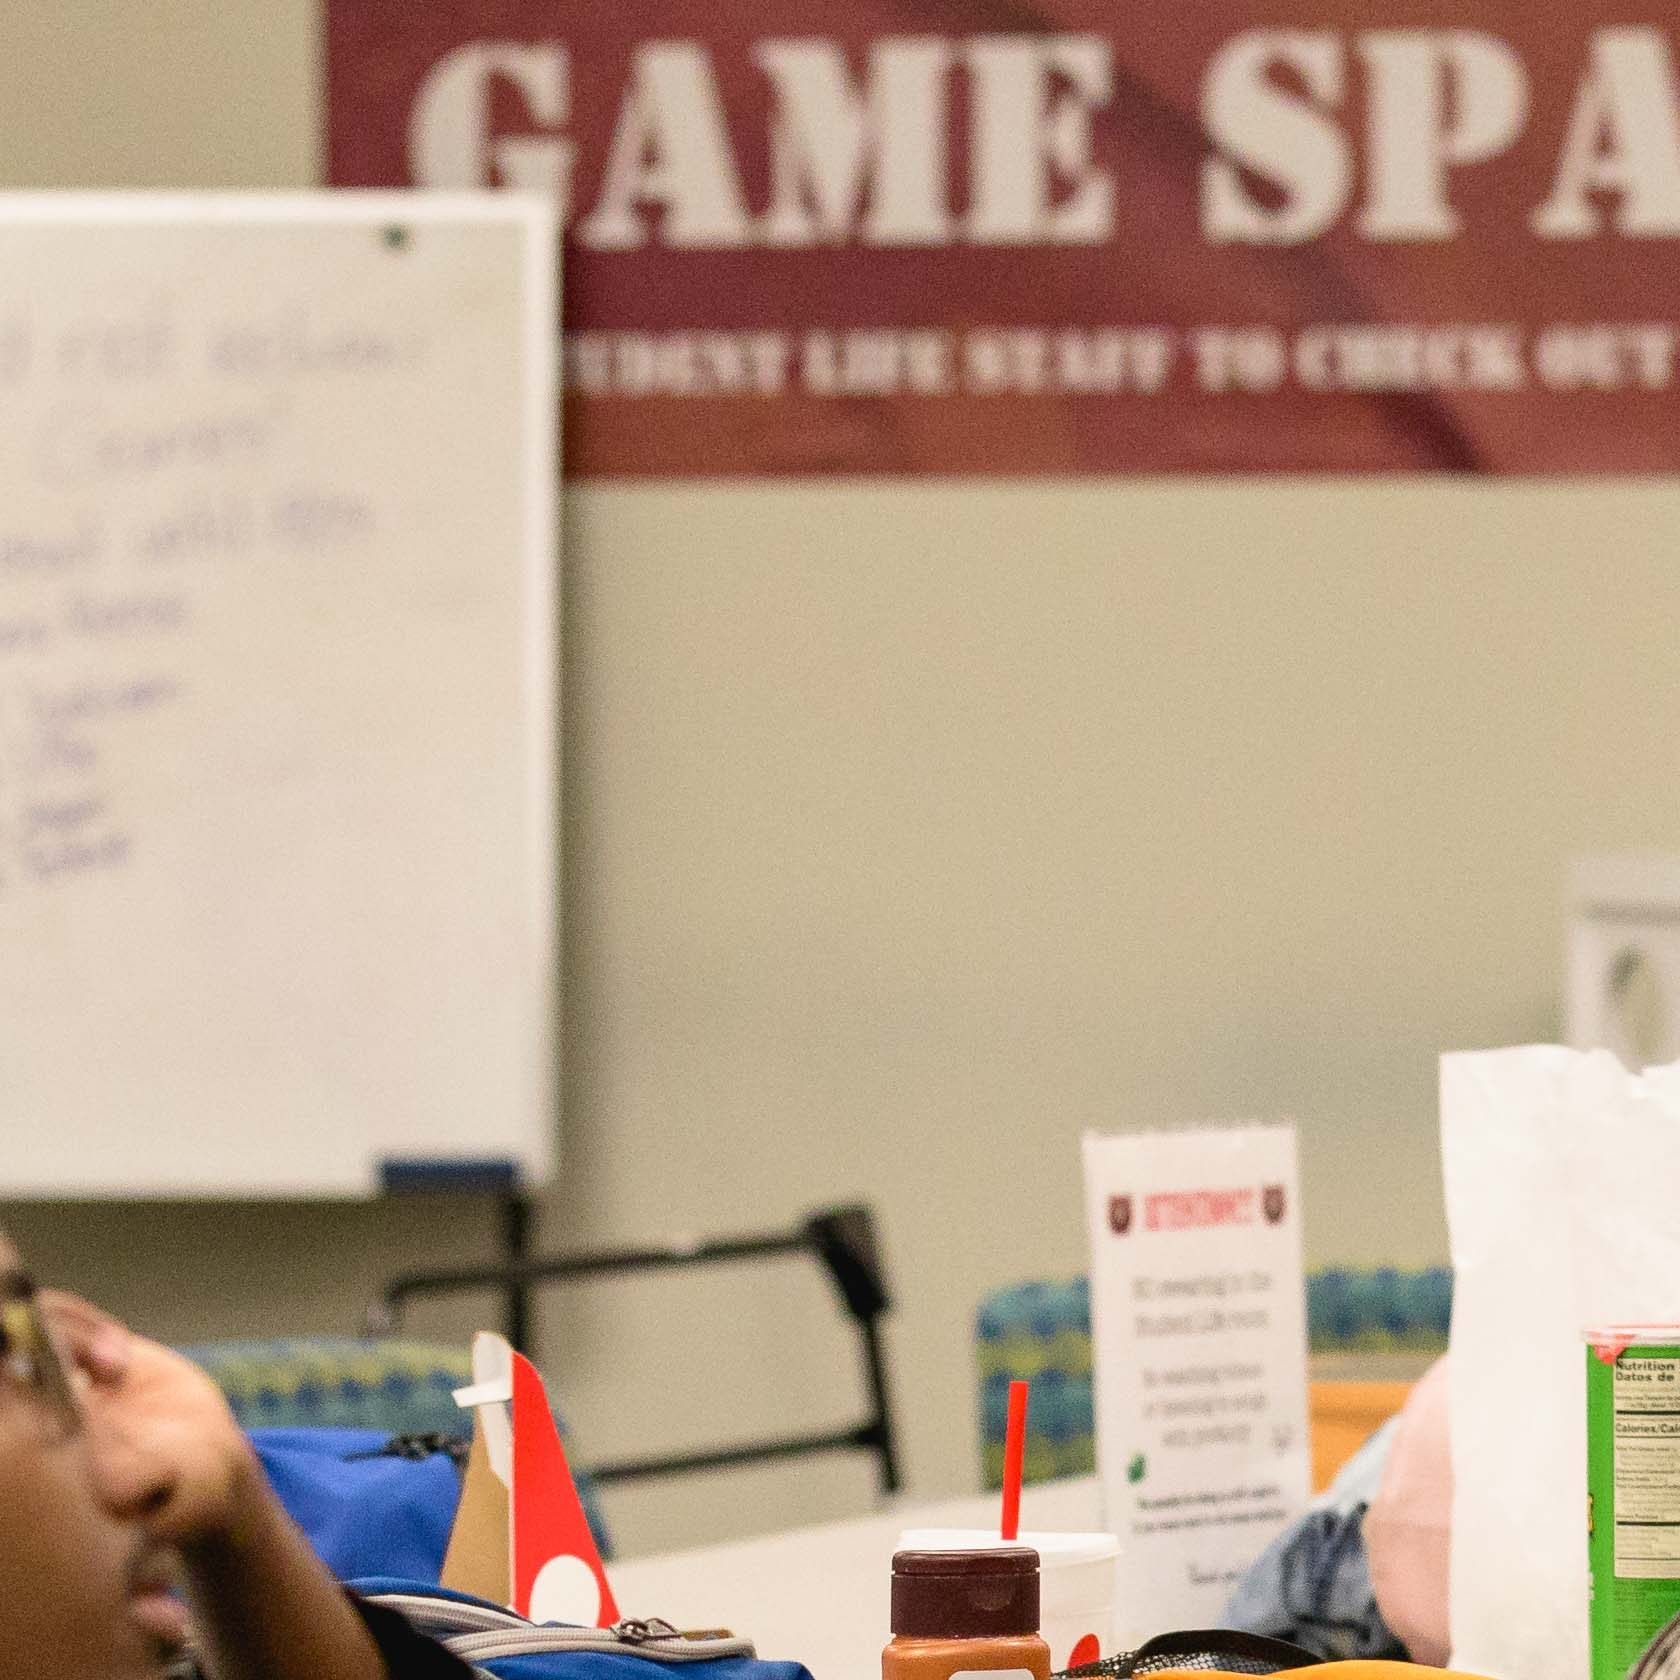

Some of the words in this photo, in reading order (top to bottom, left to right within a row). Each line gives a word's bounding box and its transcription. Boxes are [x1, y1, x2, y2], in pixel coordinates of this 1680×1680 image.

[406, 34, 1117, 250] GAME
[563, 328, 788, 398] UDENT
[802, 326, 949, 396] LIFE
[964, 325, 1168, 396] STAFF
[1197, 324, 1288, 394] TO
[1292, 322, 1523, 393] CHECK
[1535, 322, 1674, 392] OUT
[1615, 1361, 1675, 1371] Nutrition
[1615, 1372, 1653, 1382] Datos
[1657, 1372, 1675, 1382] de
